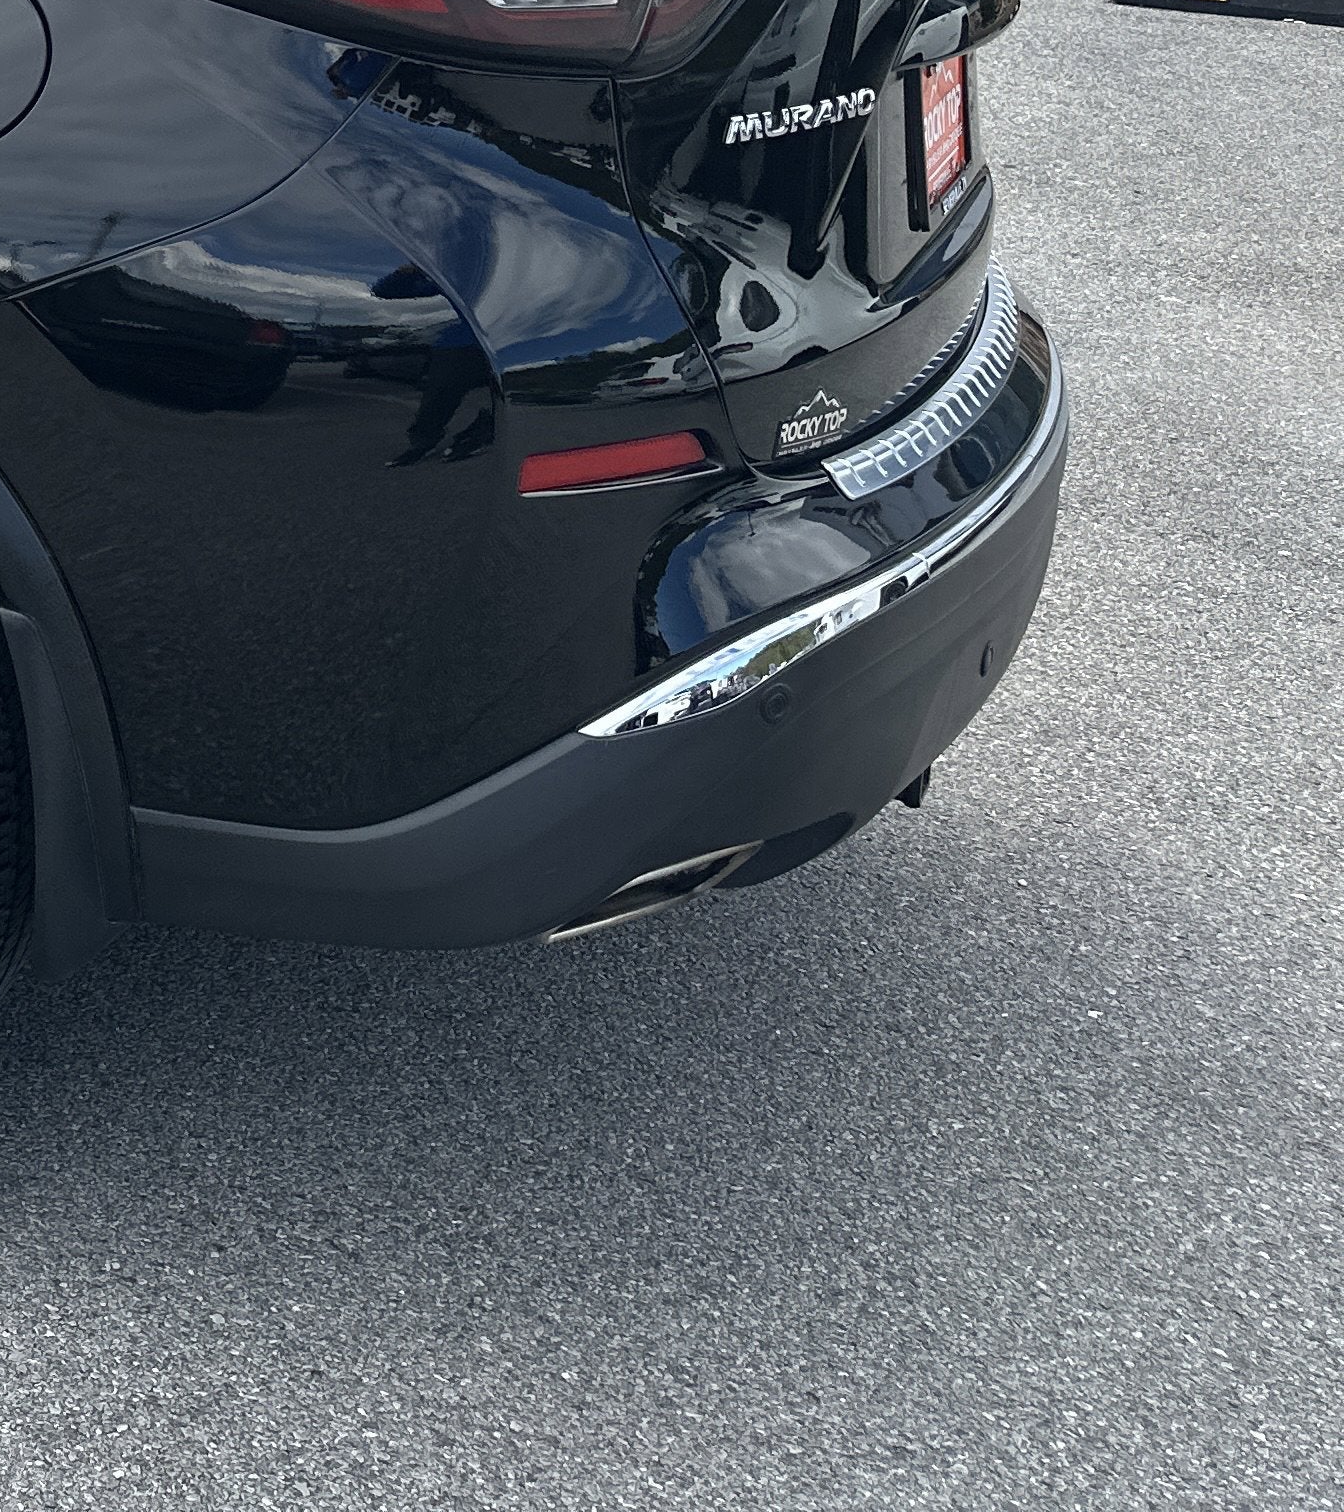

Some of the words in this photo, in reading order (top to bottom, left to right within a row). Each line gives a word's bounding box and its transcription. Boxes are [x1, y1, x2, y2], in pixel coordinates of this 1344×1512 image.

[724, 88, 876, 145] MURANO
[779, 414, 824, 444] ROCKY
[824, 407, 848, 433] TOP
